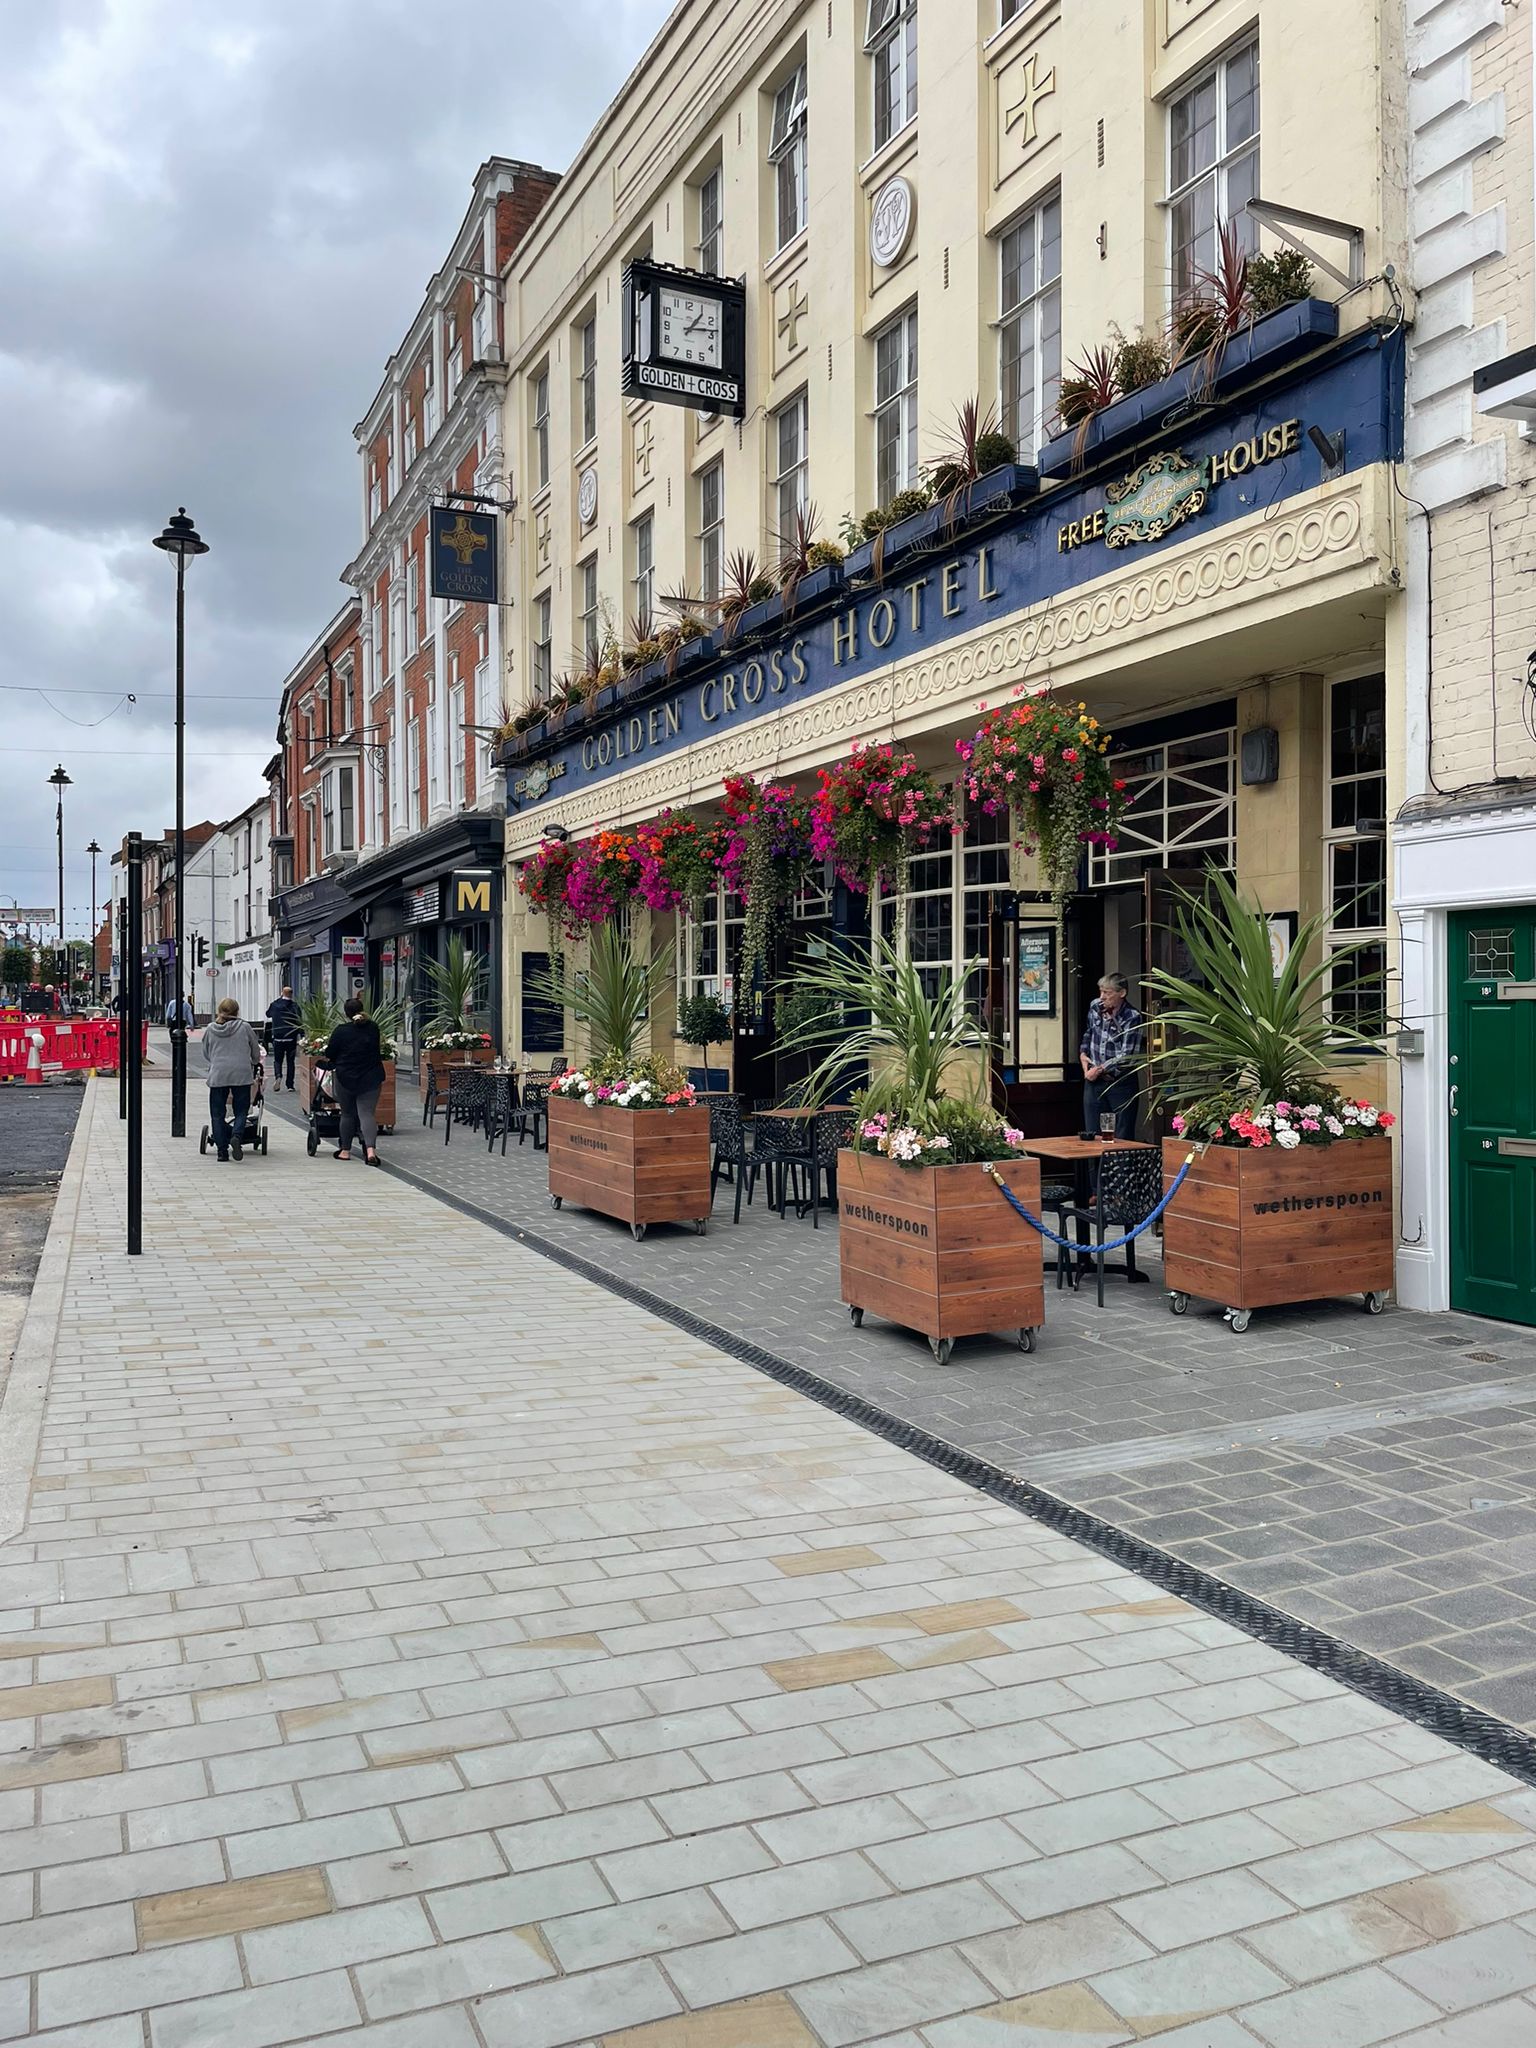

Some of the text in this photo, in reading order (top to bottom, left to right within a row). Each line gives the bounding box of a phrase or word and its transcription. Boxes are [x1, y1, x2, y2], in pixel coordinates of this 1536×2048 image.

[674, 299, 680, 308] 11
[685, 301, 694, 312] 12
[663, 306, 672, 316] 10
[664, 321, 671, 330] 9
[708, 316, 715, 326] 2
[664, 335, 671, 344] 8
[673, 346, 680, 356] 7
[708, 344, 714, 353] 4
[685, 350, 693, 359] 6
[698, 352, 706, 362] 5
[641, 367, 736, 400] GOLDEN CROSS
[1211, 418, 1300, 484] HOUSE
[1057, 509, 1104, 553] FREE
[440, 571, 488, 585] GOLDEN
[447, 581, 482, 594] CROSS
[581, 547, 998, 771] GOLDEN CROSS HOTEL
[457, 881, 491, 912] M
[1021, 938, 1049, 946] Afternoon
[1026, 945, 1043, 953] deals
[569, 1134, 608, 1152] wetherspoon
[1253, 1189, 1382, 1215] wetherspoon
[845, 1203, 929, 1237] wetherspoon
